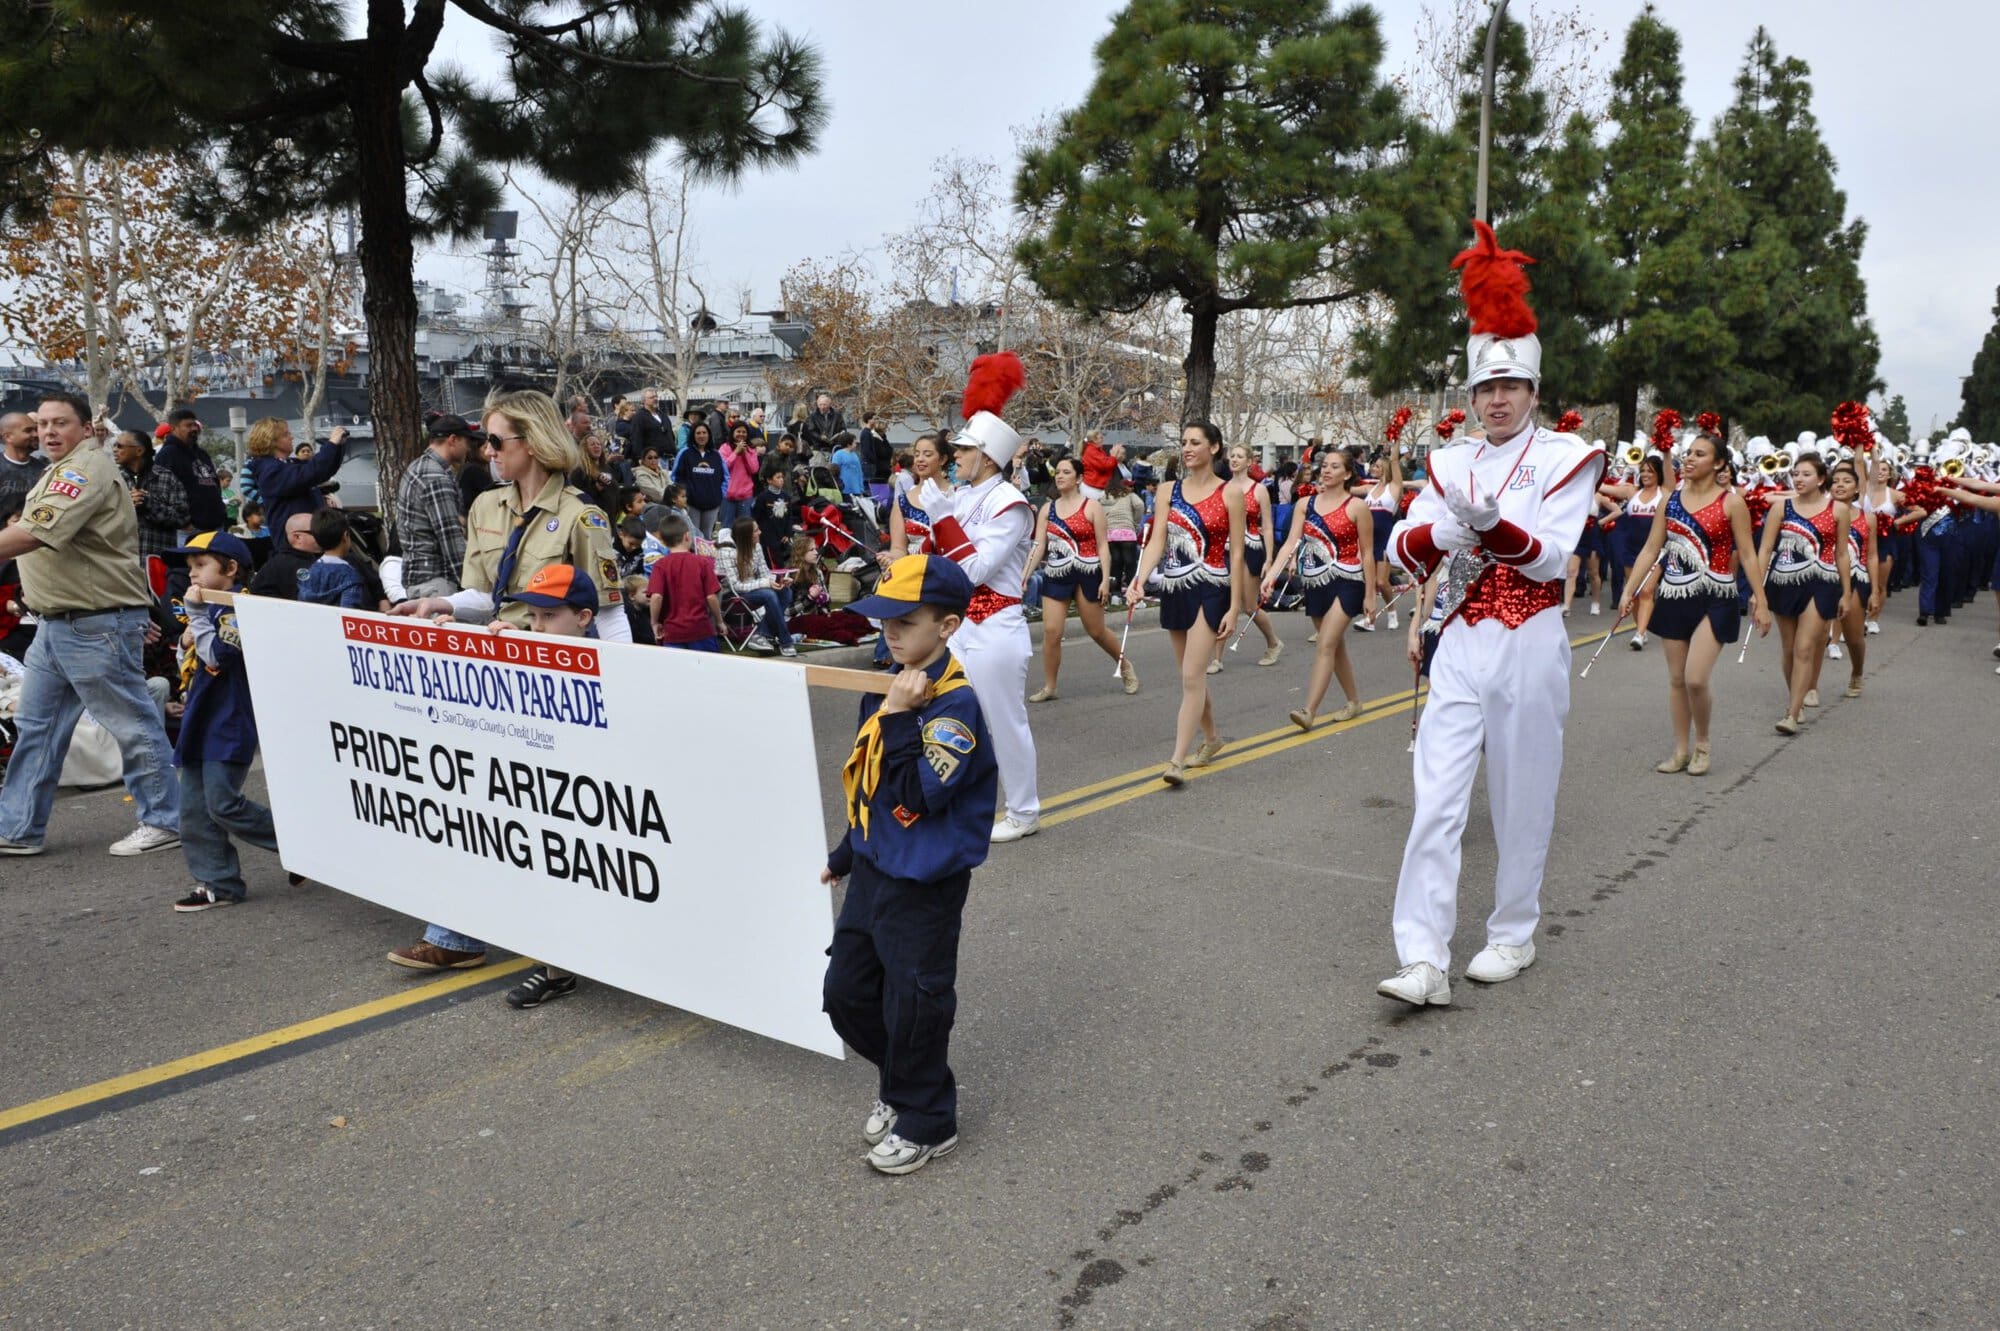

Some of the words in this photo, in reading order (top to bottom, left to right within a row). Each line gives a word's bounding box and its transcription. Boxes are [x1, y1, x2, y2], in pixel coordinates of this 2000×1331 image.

[50, 481, 80, 497] 1216
[1632, 505, 1640, 513] U
[345, 621, 400, 642] PORT
[409, 630, 437, 647] OF
[447, 635, 496, 656] SAN
[505, 642, 594, 670] DIEGO
[347, 645, 381, 690] BIG
[379, 650, 416, 696] BAY
[416, 656, 515, 714] BALLOON
[515, 670, 608, 729] PARADE
[394, 702, 416, 713] Presented
[417, 707, 423, 715] by
[478, 718, 506, 737] County
[507, 723, 529, 739] Credit
[530, 727, 554, 745] Union
[329, 721, 424, 785] PRIDE
[429, 744, 475, 795] OF
[488, 757, 672, 844] ARIZONA
[350, 778, 534, 871] MARCHING
[541, 829, 660, 903] BAND
